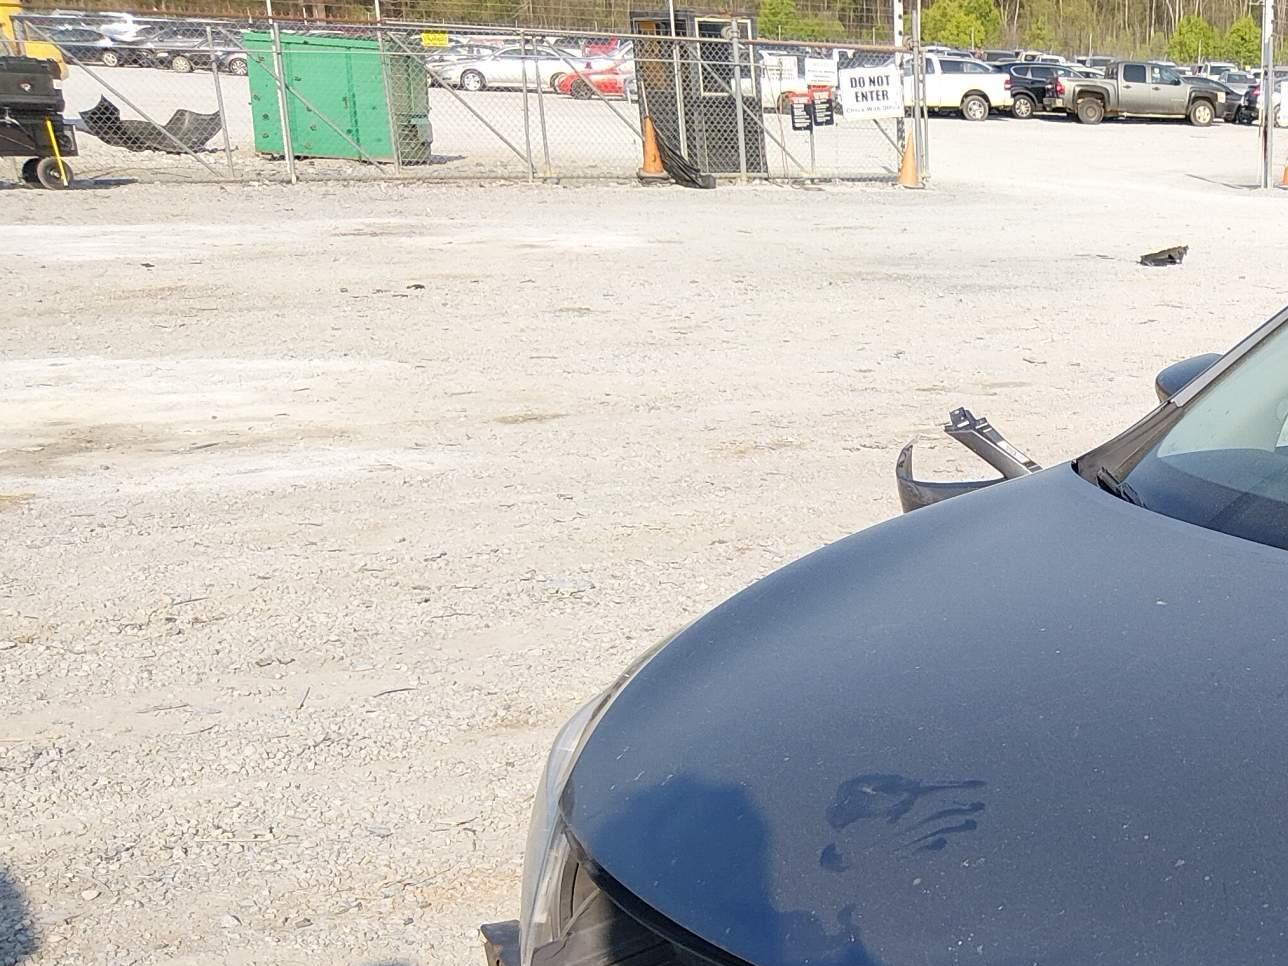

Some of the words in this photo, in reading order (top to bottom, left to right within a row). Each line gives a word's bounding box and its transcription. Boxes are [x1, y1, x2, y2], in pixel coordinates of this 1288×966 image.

[849, 76, 866, 88] DO
[868, 74, 890, 87] NOT
[854, 89, 890, 103] ENTER
